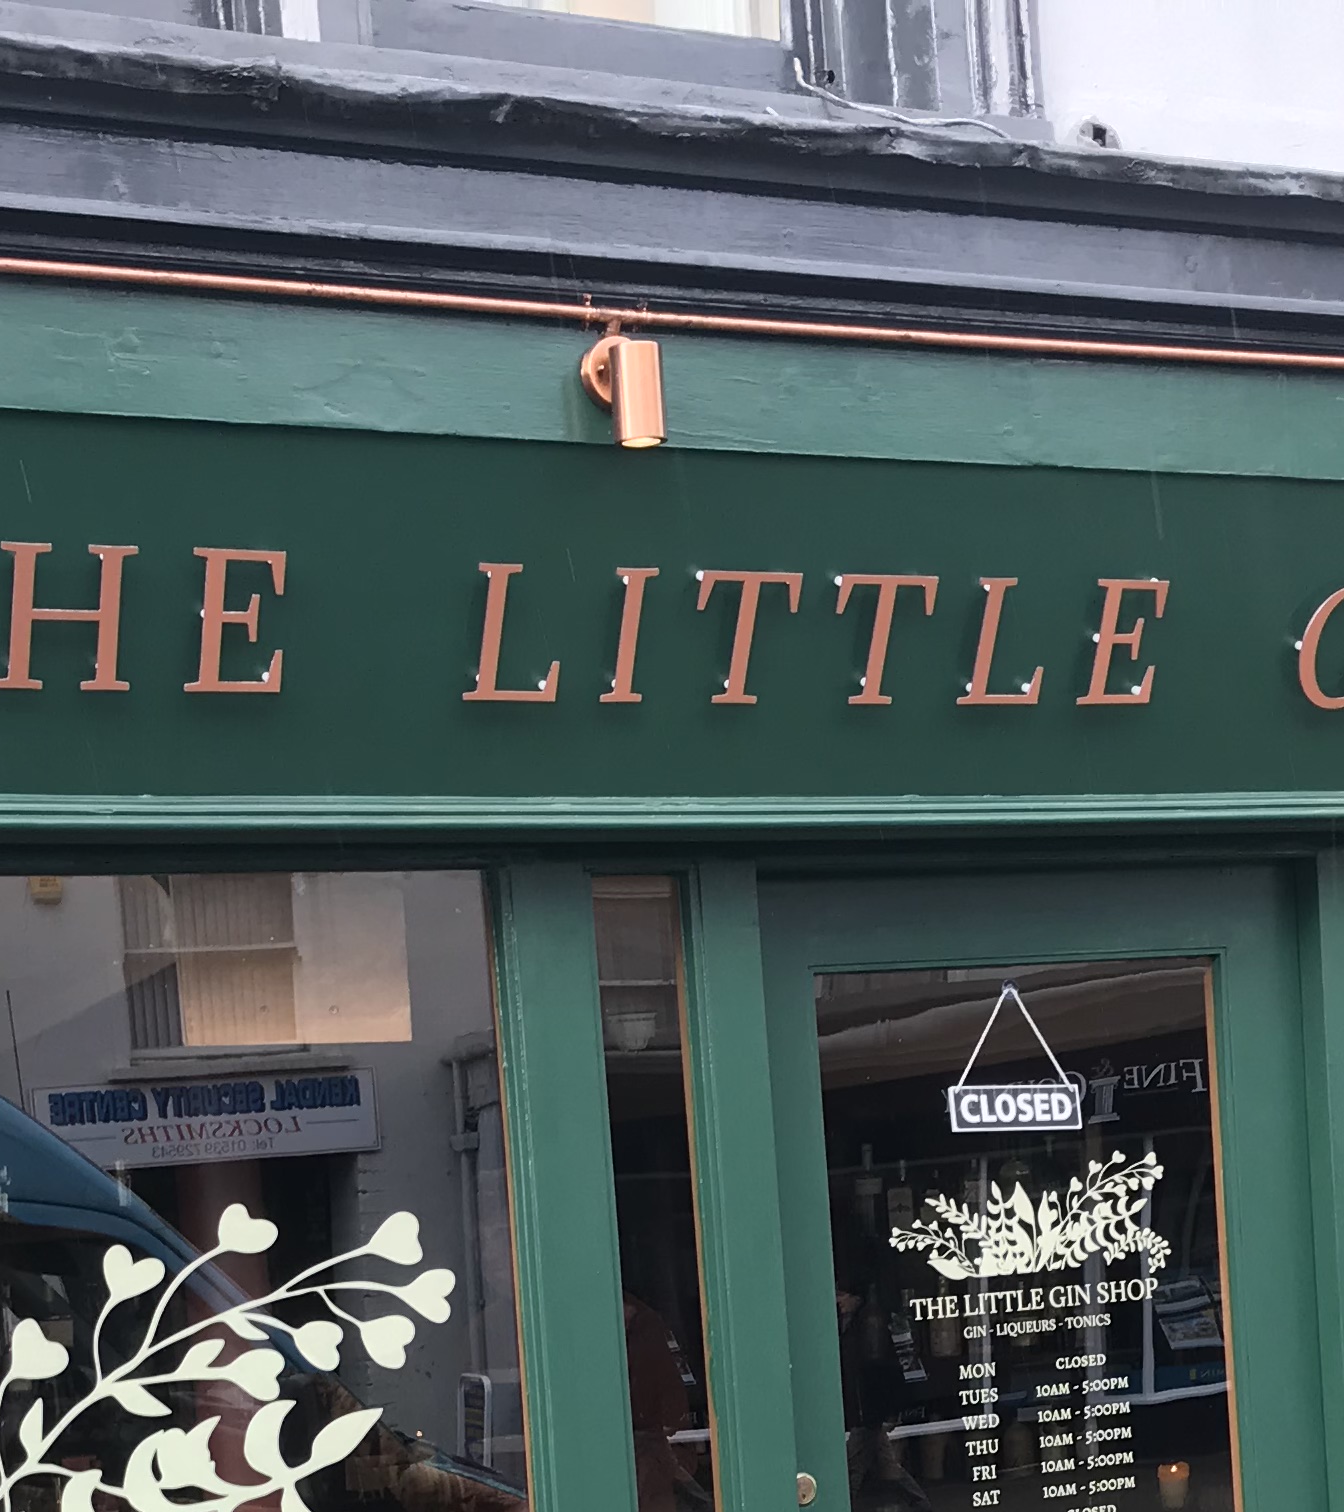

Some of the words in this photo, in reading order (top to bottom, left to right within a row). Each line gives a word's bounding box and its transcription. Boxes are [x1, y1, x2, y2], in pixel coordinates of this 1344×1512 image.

[461, 562, 1170, 706] LITTLE
[960, 1093, 1073, 1124] CLOSED
[909, 1295, 960, 1321] THE
[963, 1288, 1045, 1317] LITTLE
[1049, 1283, 1091, 1309] GIN
[1097, 1277, 1158, 1304] SHOP
[964, 1325, 986, 1340] GIN
[996, 1318, 1056, 1338] LIQUEURS
[1065, 1313, 1111, 1330] TONICS
[959, 1362, 996, 1380] MON
[1056, 1353, 1106, 1370] CLOSED
[959, 1388, 998, 1405] TUES
[1036, 1382, 1070, 1398] 10AM
[1082, 1376, 1129, 1394] 5:00PM
[962, 1414, 1000, 1430] WED
[1037, 1407, 1072, 1423] 10AM
[1084, 1401, 1131, 1419] 5:00PM
[965, 1439, 999, 1456] THU
[1039, 1433, 1074, 1448] 10AM
[1085, 1427, 1132, 1445] 5:00PM
[972, 1465, 997, 1482] FRI
[1041, 1458, 1075, 1473] 10AM
[1087, 1451, 1134, 1470] 5:00PM
[972, 1490, 1000, 1507] SAT
[1042, 1483, 1077, 1498] 10AM
[1089, 1476, 1136, 1495] 5:00PM
